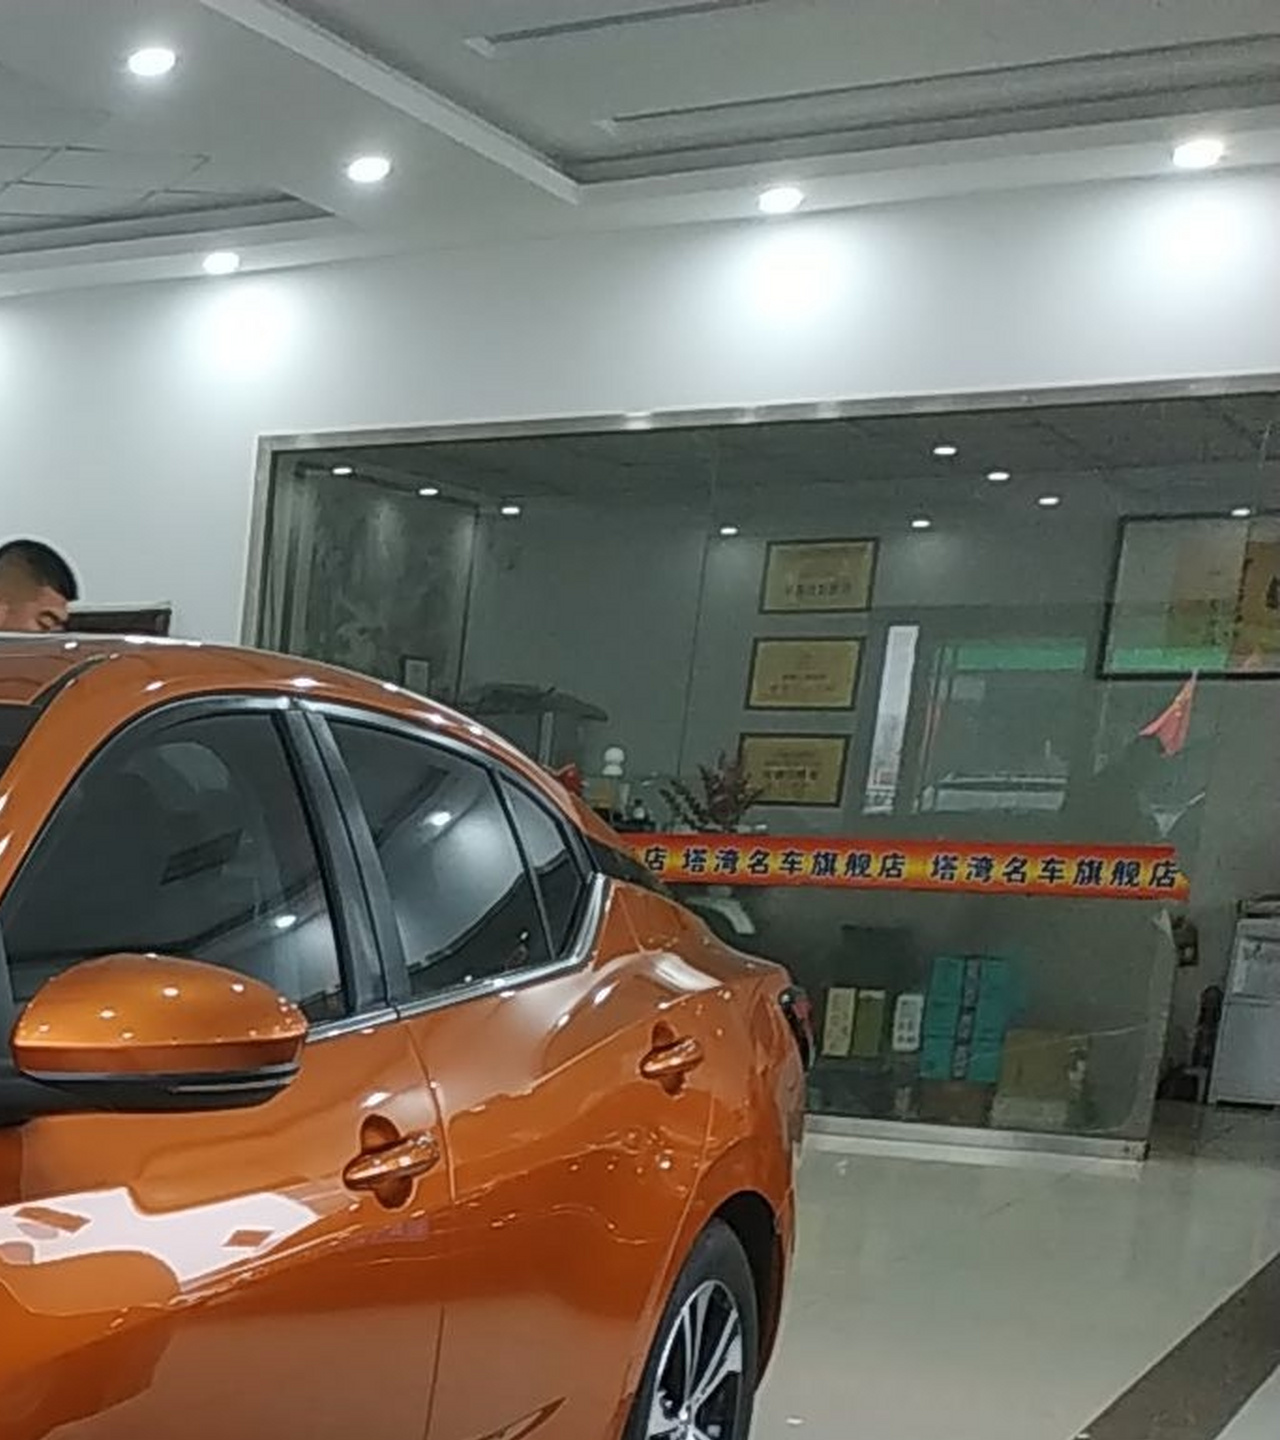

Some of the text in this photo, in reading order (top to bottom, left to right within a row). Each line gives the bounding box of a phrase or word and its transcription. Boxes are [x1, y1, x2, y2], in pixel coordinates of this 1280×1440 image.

[681, 847, 906, 878] 塔湾名车旗舰店
[930, 854, 1178, 888] 塔湾名车旗舰店
